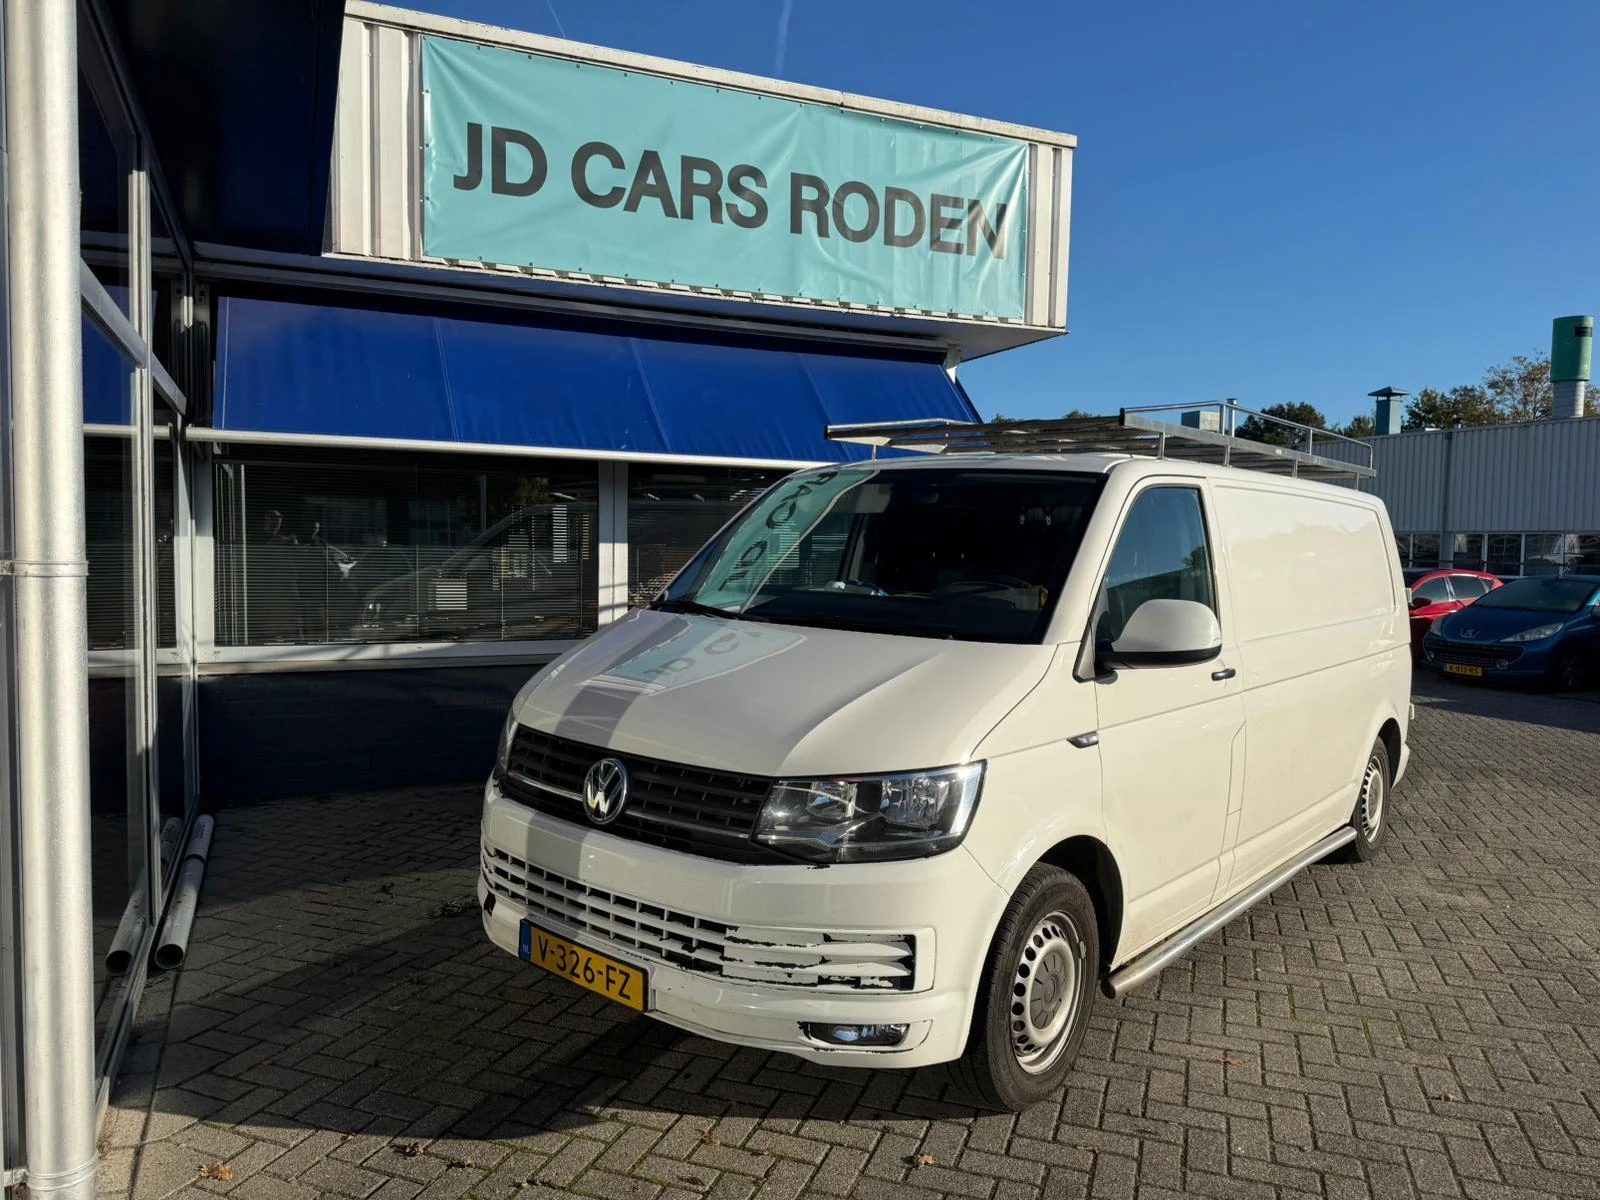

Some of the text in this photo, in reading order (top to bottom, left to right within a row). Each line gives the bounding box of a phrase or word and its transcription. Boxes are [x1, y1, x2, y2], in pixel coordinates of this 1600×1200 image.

[453, 121, 1007, 260] JD CARS RODEN
[522, 935, 631, 1000] NL V-326-FZ
